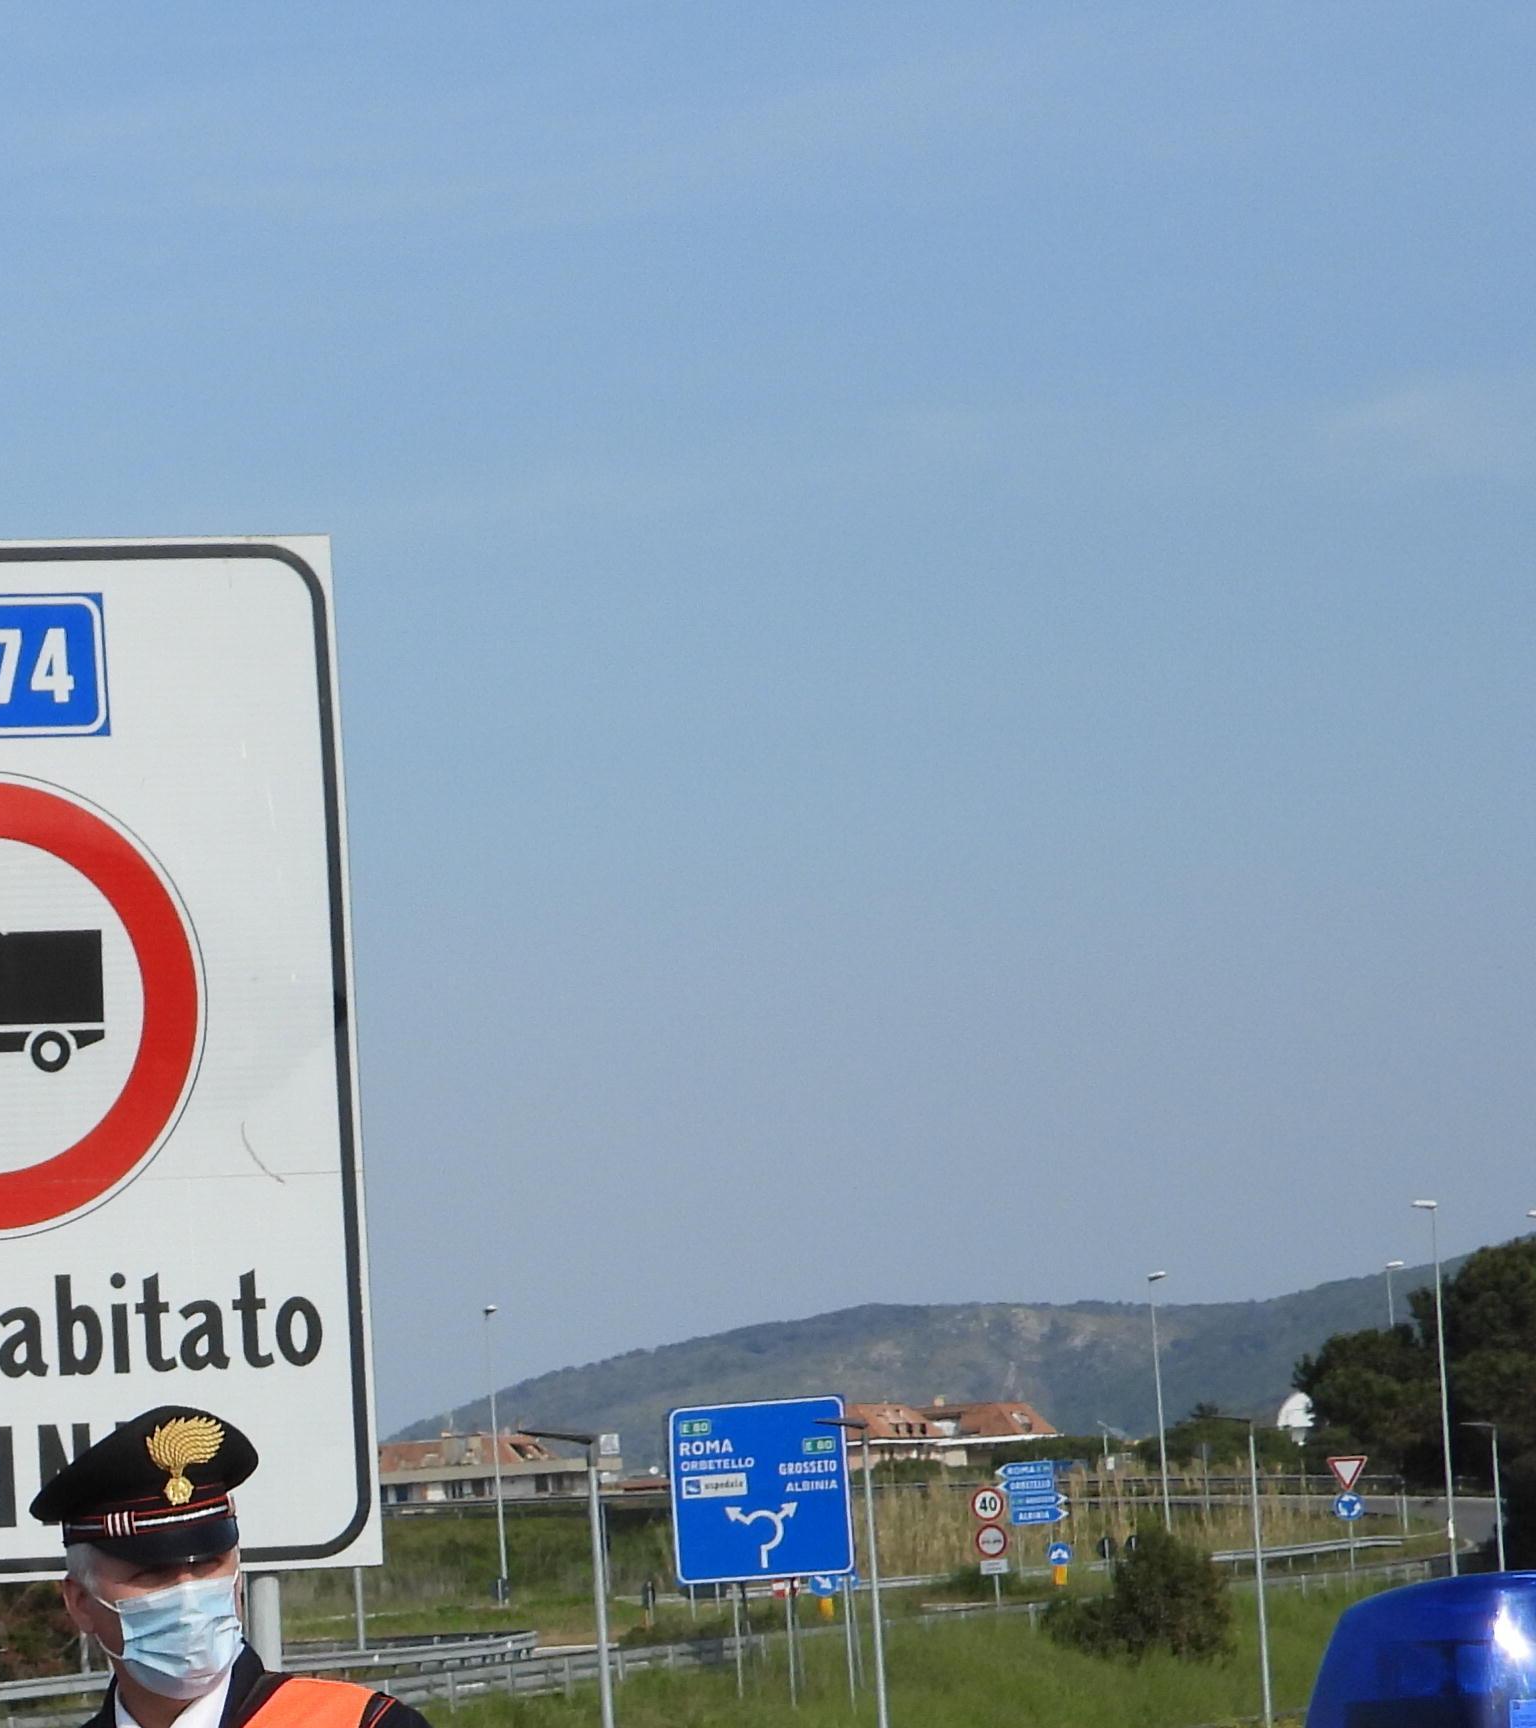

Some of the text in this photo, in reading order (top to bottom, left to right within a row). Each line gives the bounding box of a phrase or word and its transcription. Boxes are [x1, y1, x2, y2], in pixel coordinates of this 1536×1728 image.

[679, 1439, 733, 1456] ROMA
[680, 1457, 755, 1472] ORBETELLO
[779, 1460, 837, 1475] GROSSETO
[786, 1479, 838, 1492] ALBINIA
[979, 1496, 997, 1512] 40
